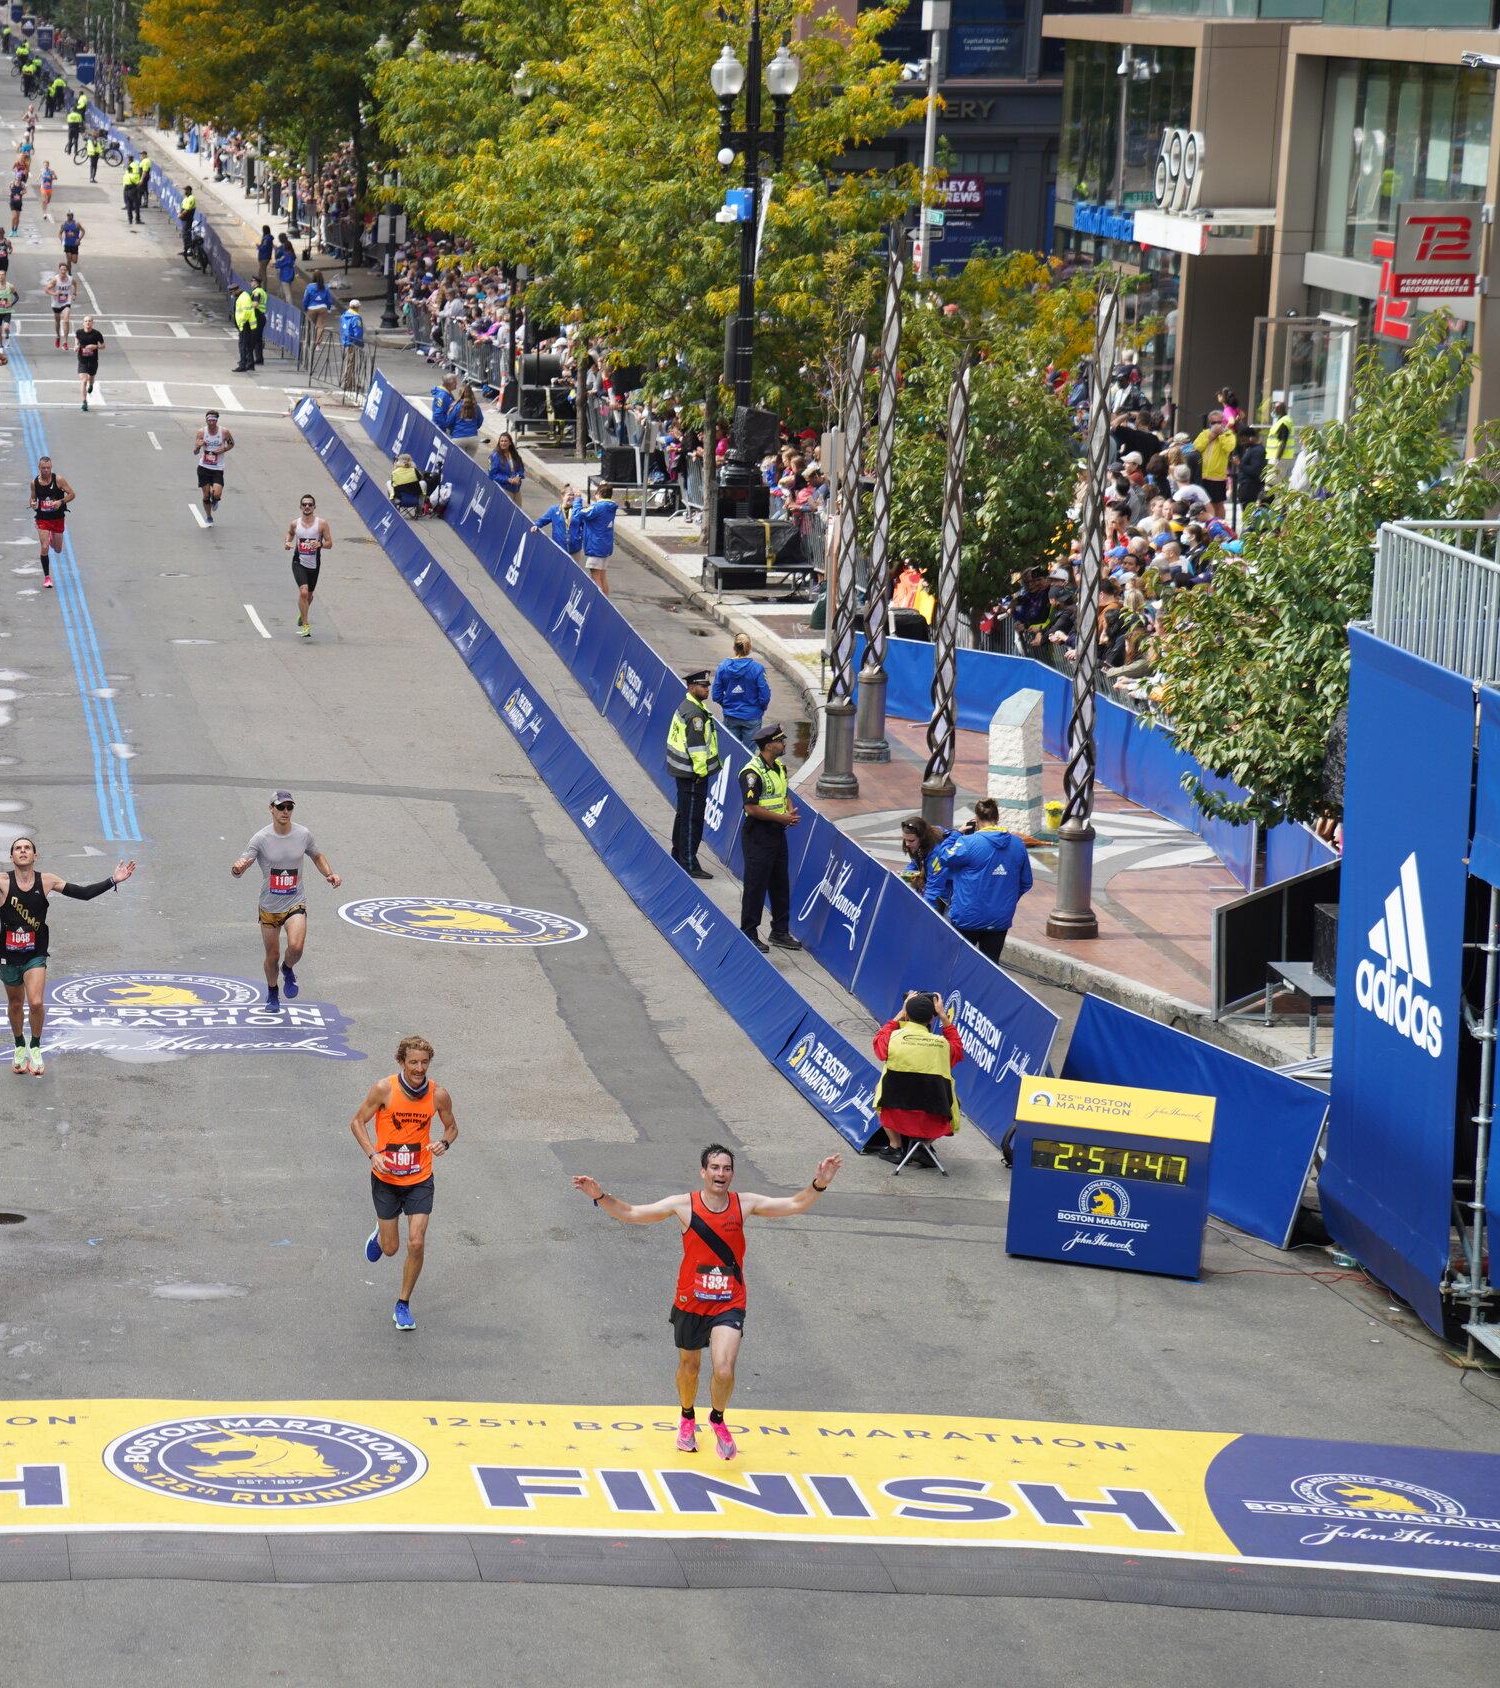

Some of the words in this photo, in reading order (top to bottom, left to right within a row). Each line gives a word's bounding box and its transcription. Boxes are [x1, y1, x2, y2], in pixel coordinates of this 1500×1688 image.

[967, 180, 977, 191] &
[1400, 277, 1460, 286] PERFORMANCE
[1400, 285, 1438, 293] RECOVERY
[1439, 285, 1470, 293] CENTER
[116, 1006, 322, 1018] BOSTON
[1355, 958, 1443, 1058] adidas
[960, 1000, 979, 1028] THE
[974, 1011, 1003, 1051] BOSTON
[957, 1022, 997, 1074] MARATHON
[810, 1041, 829, 1066] THE
[821, 1052, 852, 1087] BOSTON
[797, 1059, 843, 1105] MARATHON
[1056, 1093, 1083, 1103] 125TH
[1084, 1096, 1132, 1109] BOSTON
[1056, 1101, 1132, 1117] MARATHON
[1053, 1143, 1188, 1183] 2:51:47
[1057, 1212, 1095, 1225] BOSTON
[1095, 1217, 1148, 1231] MARATHON
[1090, 1232, 1136, 1257] Hancock
[122, 1421, 211, 1465] BOSTON
[219, 1417, 402, 1464] MARATHON
[422, 1416, 548, 1428] 125TH
[817, 1427, 1130, 1453] MARATHON
[141, 1471, 220, 1497] 125th
[231, 1472, 398, 1504] RUNNING
[236, 1478, 268, 1486] EST.
[469, 1464, 1186, 1536] FINISH
[1243, 1502, 1369, 1519] BOSTON
[1299, 1523, 1388, 1546] John
